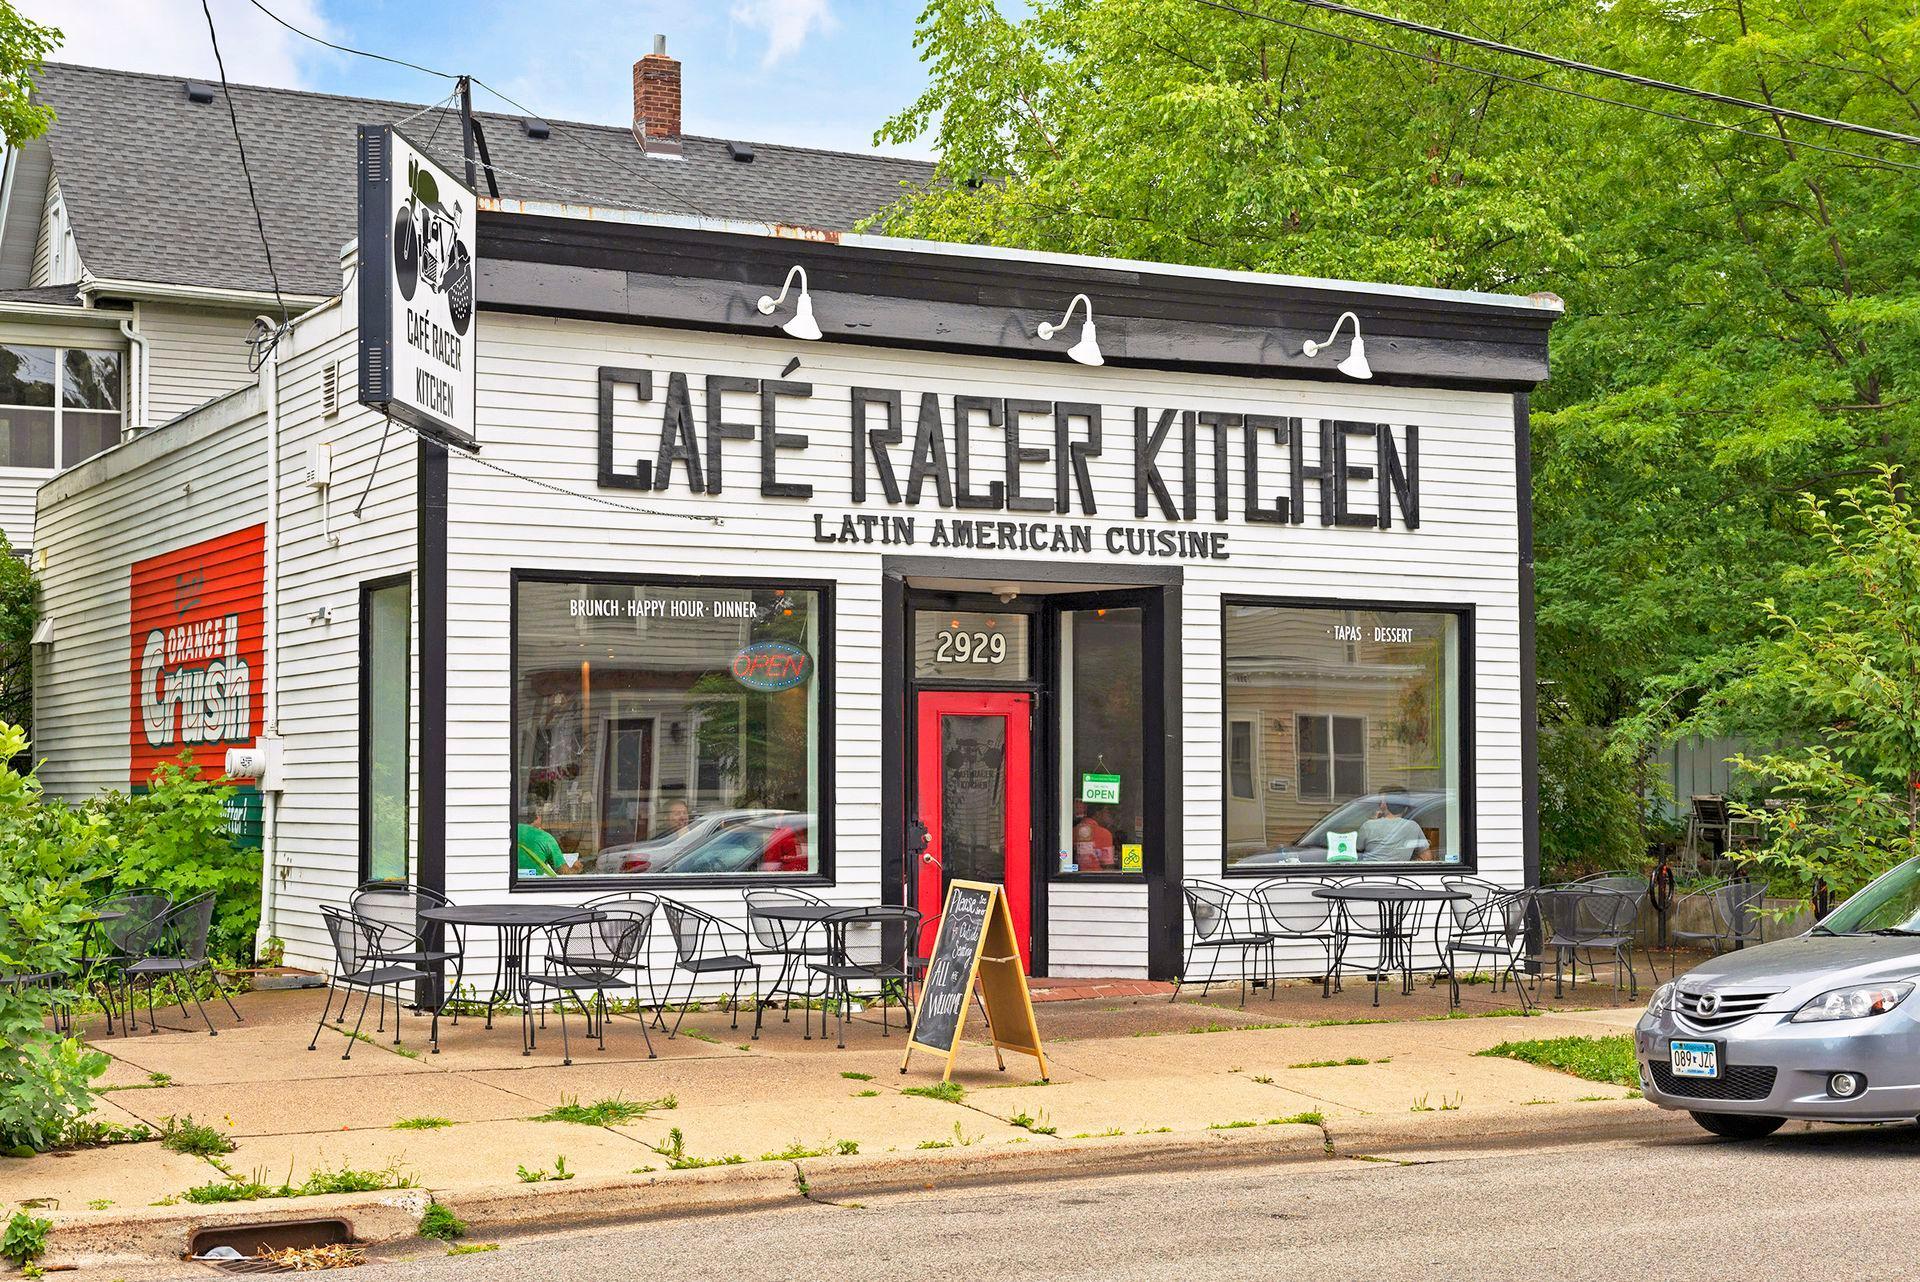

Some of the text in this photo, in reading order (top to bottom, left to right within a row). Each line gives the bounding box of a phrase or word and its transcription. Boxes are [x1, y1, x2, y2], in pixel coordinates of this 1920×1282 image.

[407, 307, 462, 372] CAFÉ RACER
[416, 367, 454, 419] KITCHEN
[597, 356, 1420, 531] CAFÉ RACER KITCHEN
[813, 514, 1231, 560] LATIN AMERICAN CUISINE
[570, 599, 758, 619] BRUNCH HAPPY HOUR DINNER
[167, 619, 223, 664] ORANGE
[936, 630, 1007, 664] 2929
[1334, 625, 1413, 643] TAPAS DESSERT
[141, 613, 250, 748] Crush
[733, 654, 805, 677] OPEN
[1086, 789, 1115, 799] OPEN
[949, 888, 977, 914] Please
[1674, 1050, 1715, 1069] 089 JZC
